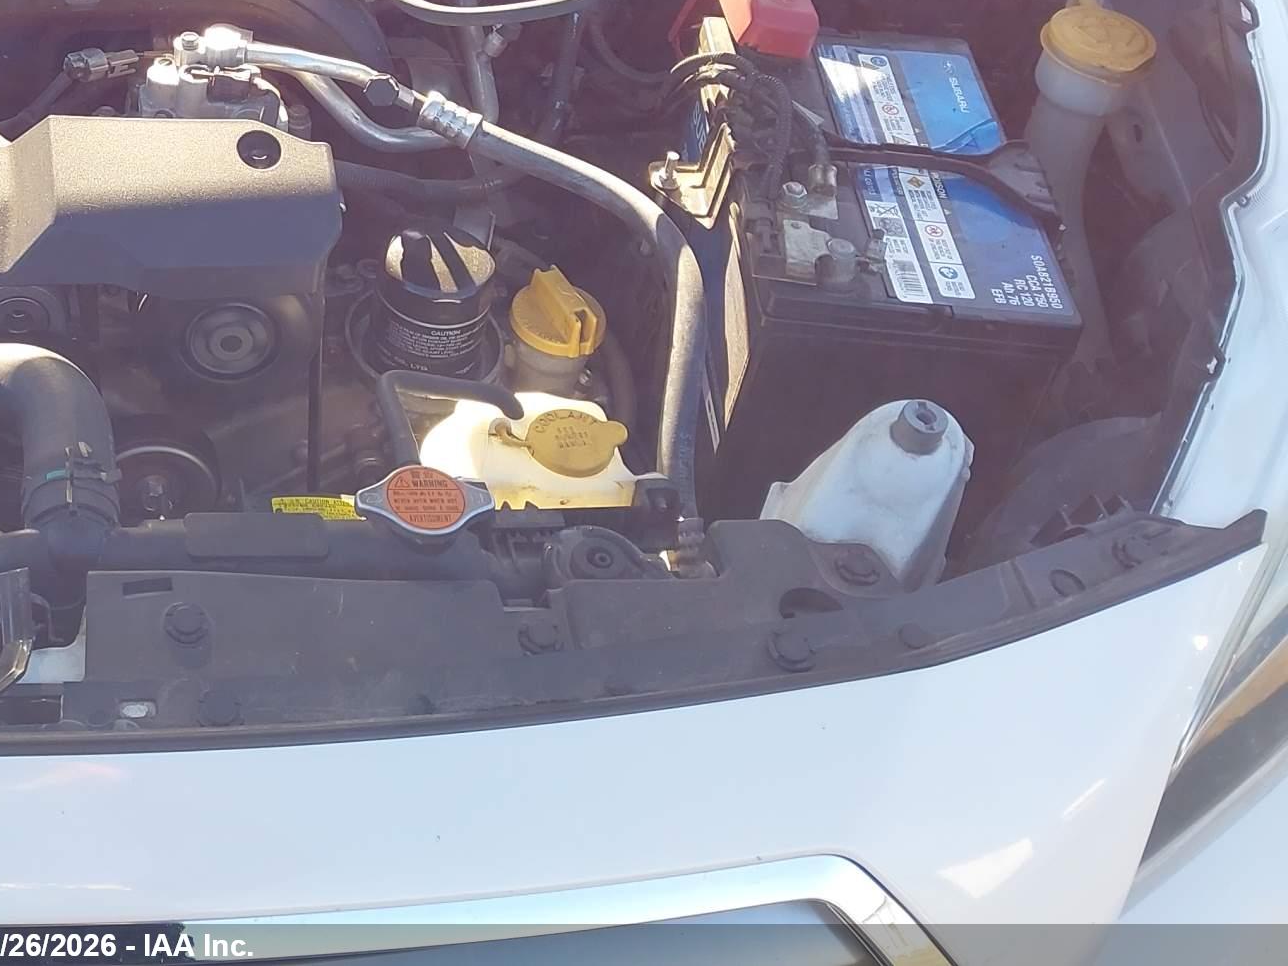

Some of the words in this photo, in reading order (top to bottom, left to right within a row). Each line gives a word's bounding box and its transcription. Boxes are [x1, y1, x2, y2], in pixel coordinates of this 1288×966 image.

[948, 76, 970, 113] SUBARU
[990, 288, 1005, 304] EFB
[1001, 282, 1015, 295] Ah
[1013, 279, 1026, 291] RC
[1020, 292, 1035, 307] 120
[1024, 274, 1038, 291] CCA
[1032, 291, 1047, 308] 750
[1007, 295, 1021, 305] 76
[535, 411, 598, 434] COOLANT
[411, 479, 448, 488] WARNING
